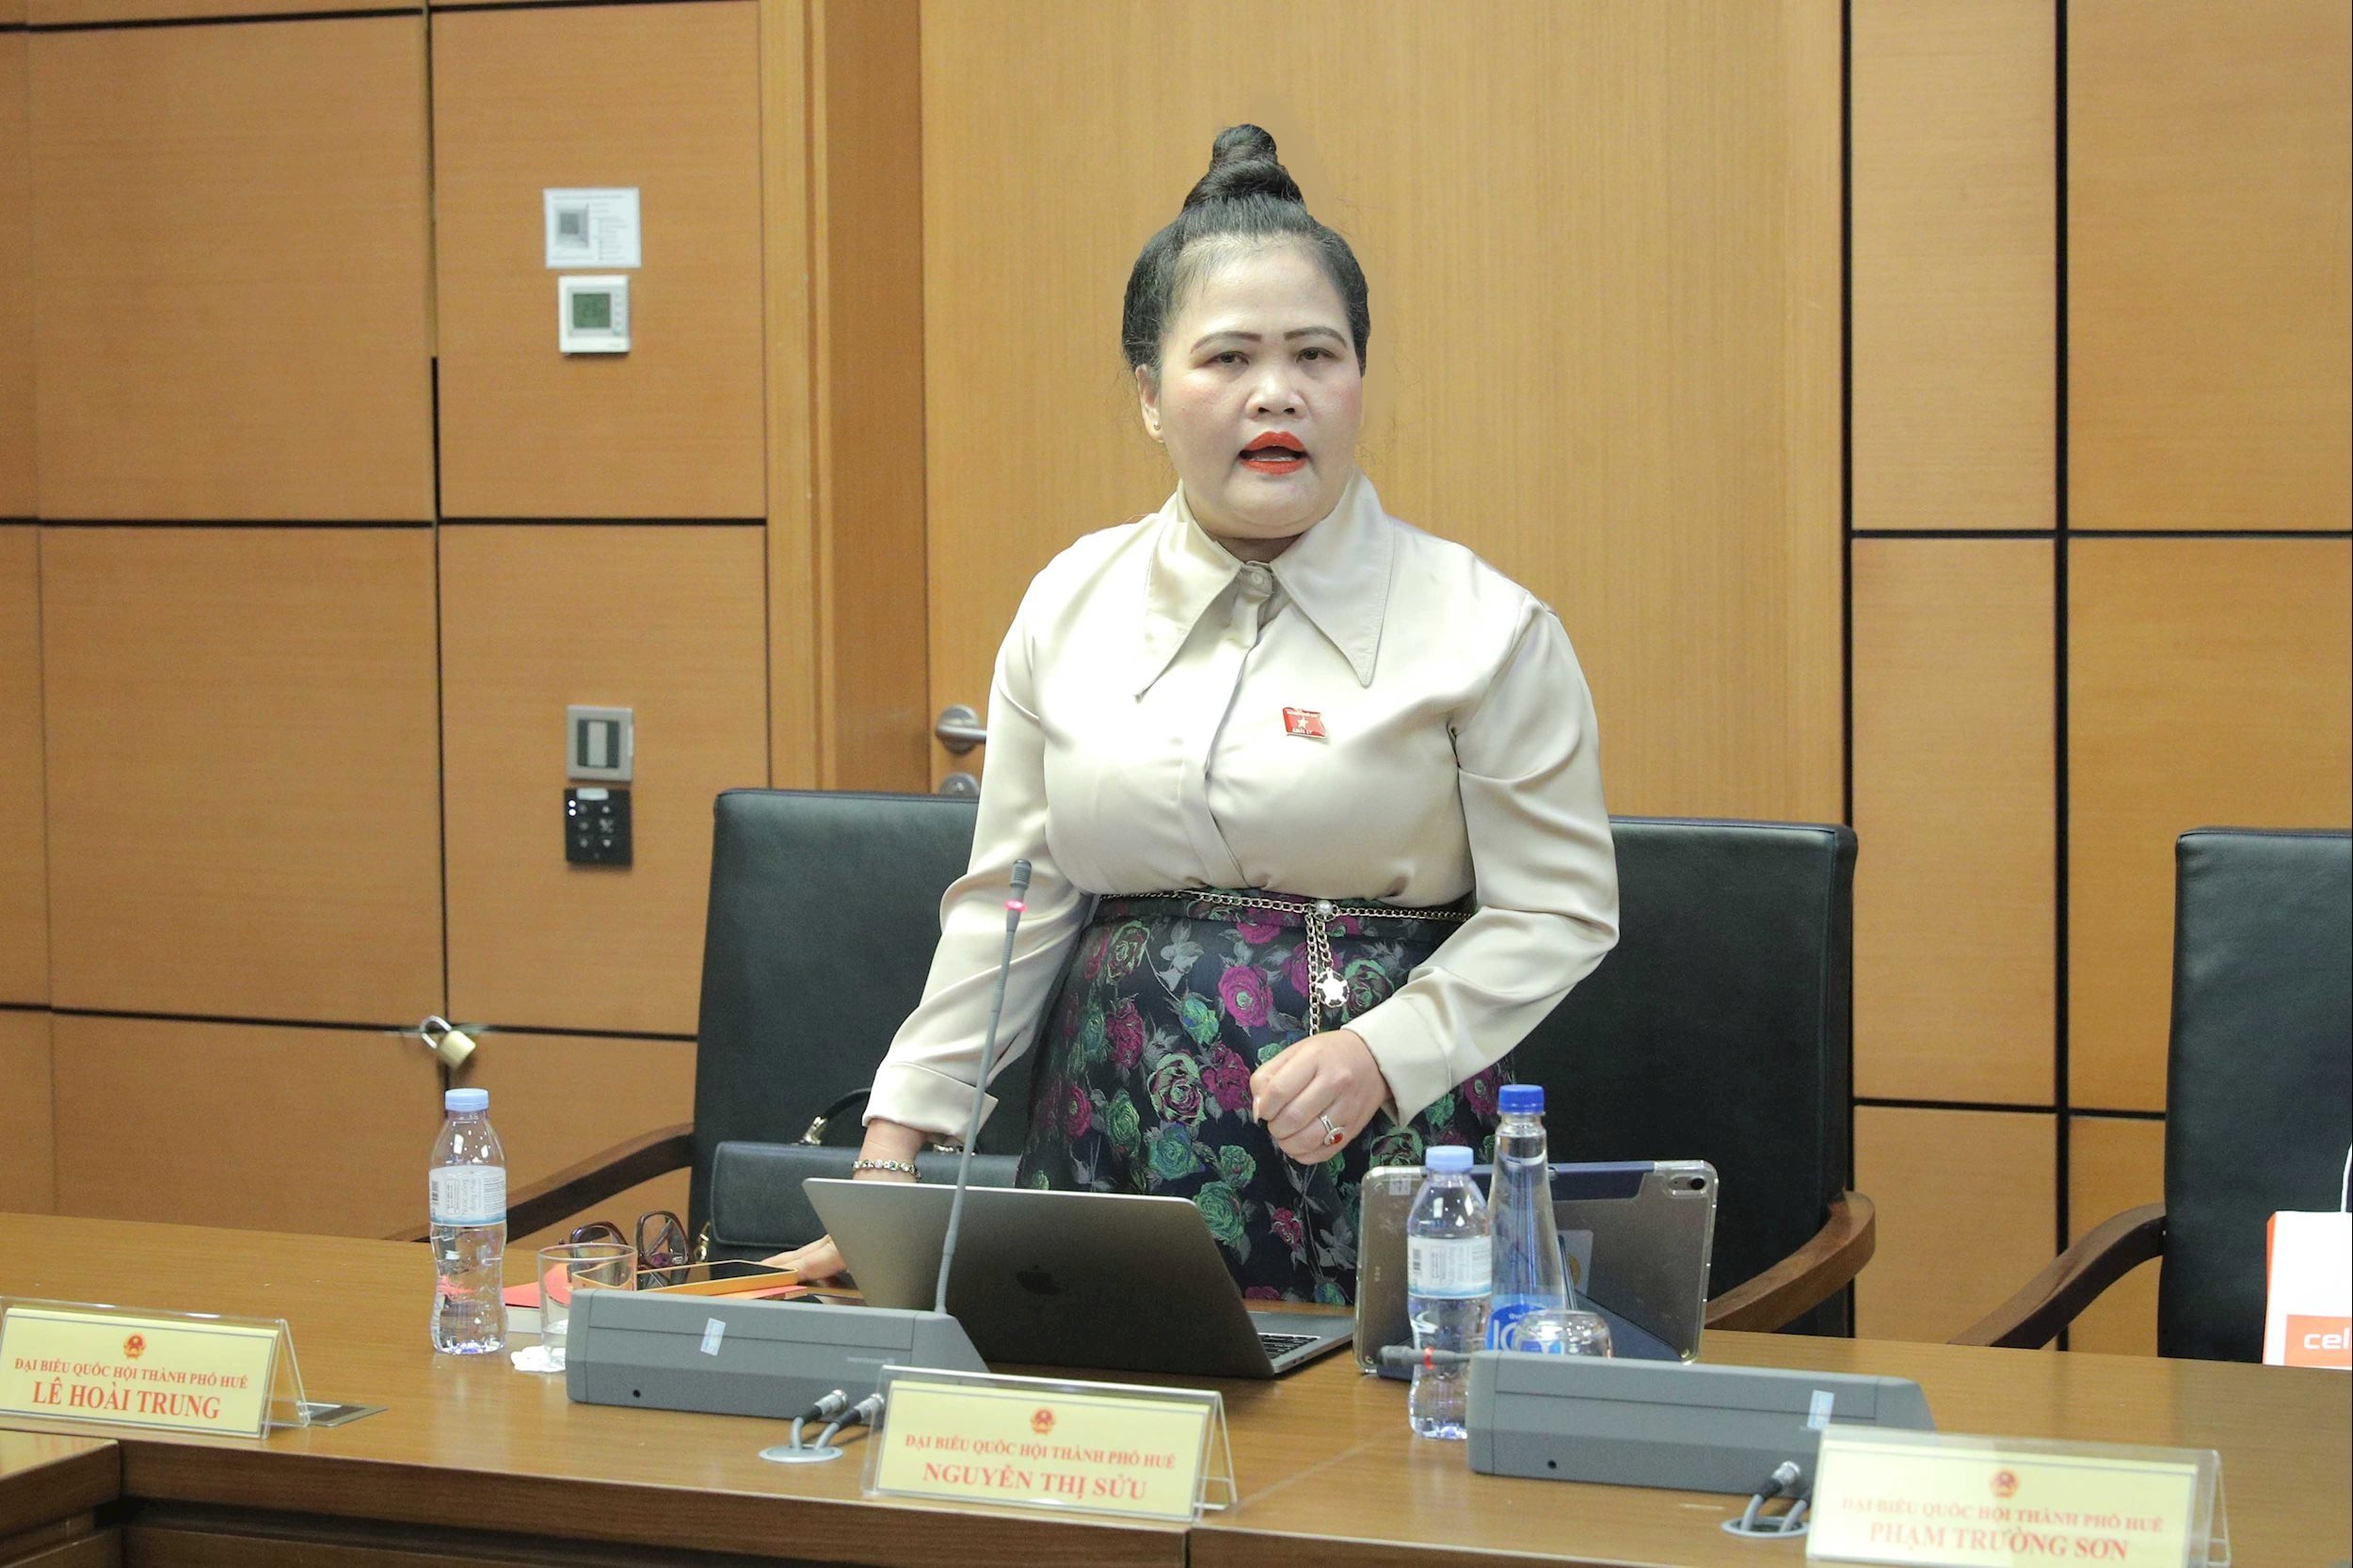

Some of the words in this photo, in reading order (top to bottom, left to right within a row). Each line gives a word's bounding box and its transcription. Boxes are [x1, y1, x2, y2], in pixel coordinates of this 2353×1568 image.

[14, 1357, 38, 1373] ĐẠI
[40, 1358, 72, 1374] BIỂU
[72, 1362, 111, 1377] QUỐC
[113, 1366, 138, 1381] HỘI
[141, 1367, 187, 1384] THÀNH
[189, 1371, 217, 1386] PHỐ
[219, 1375, 248, 1389] HUẾ
[32, 1376, 63, 1405] LÊ
[68, 1382, 132, 1411] HOÀI
[136, 1390, 221, 1419] TRUNG
[905, 1433, 932, 1450] ĐẠI
[935, 1434, 969, 1451] BIỂU
[972, 1438, 1016, 1455] QUỐC
[1019, 1442, 1048, 1460] HỘI
[1051, 1446, 1105, 1464] THÀNH
[1108, 1450, 1141, 1465] PHỐ
[1143, 1453, 1176, 1469] HUẾ
[922, 1462, 1033, 1489] NGUYỄN
[1040, 1472, 1087, 1499] THỊ
[2017, 1507, 2079, 1526] THÀNH
[1869, 1521, 1945, 1551] PHẠM
[1953, 1526, 2068, 1557] TRƯỜNG
[2073, 1536, 2129, 1560] SƠN
